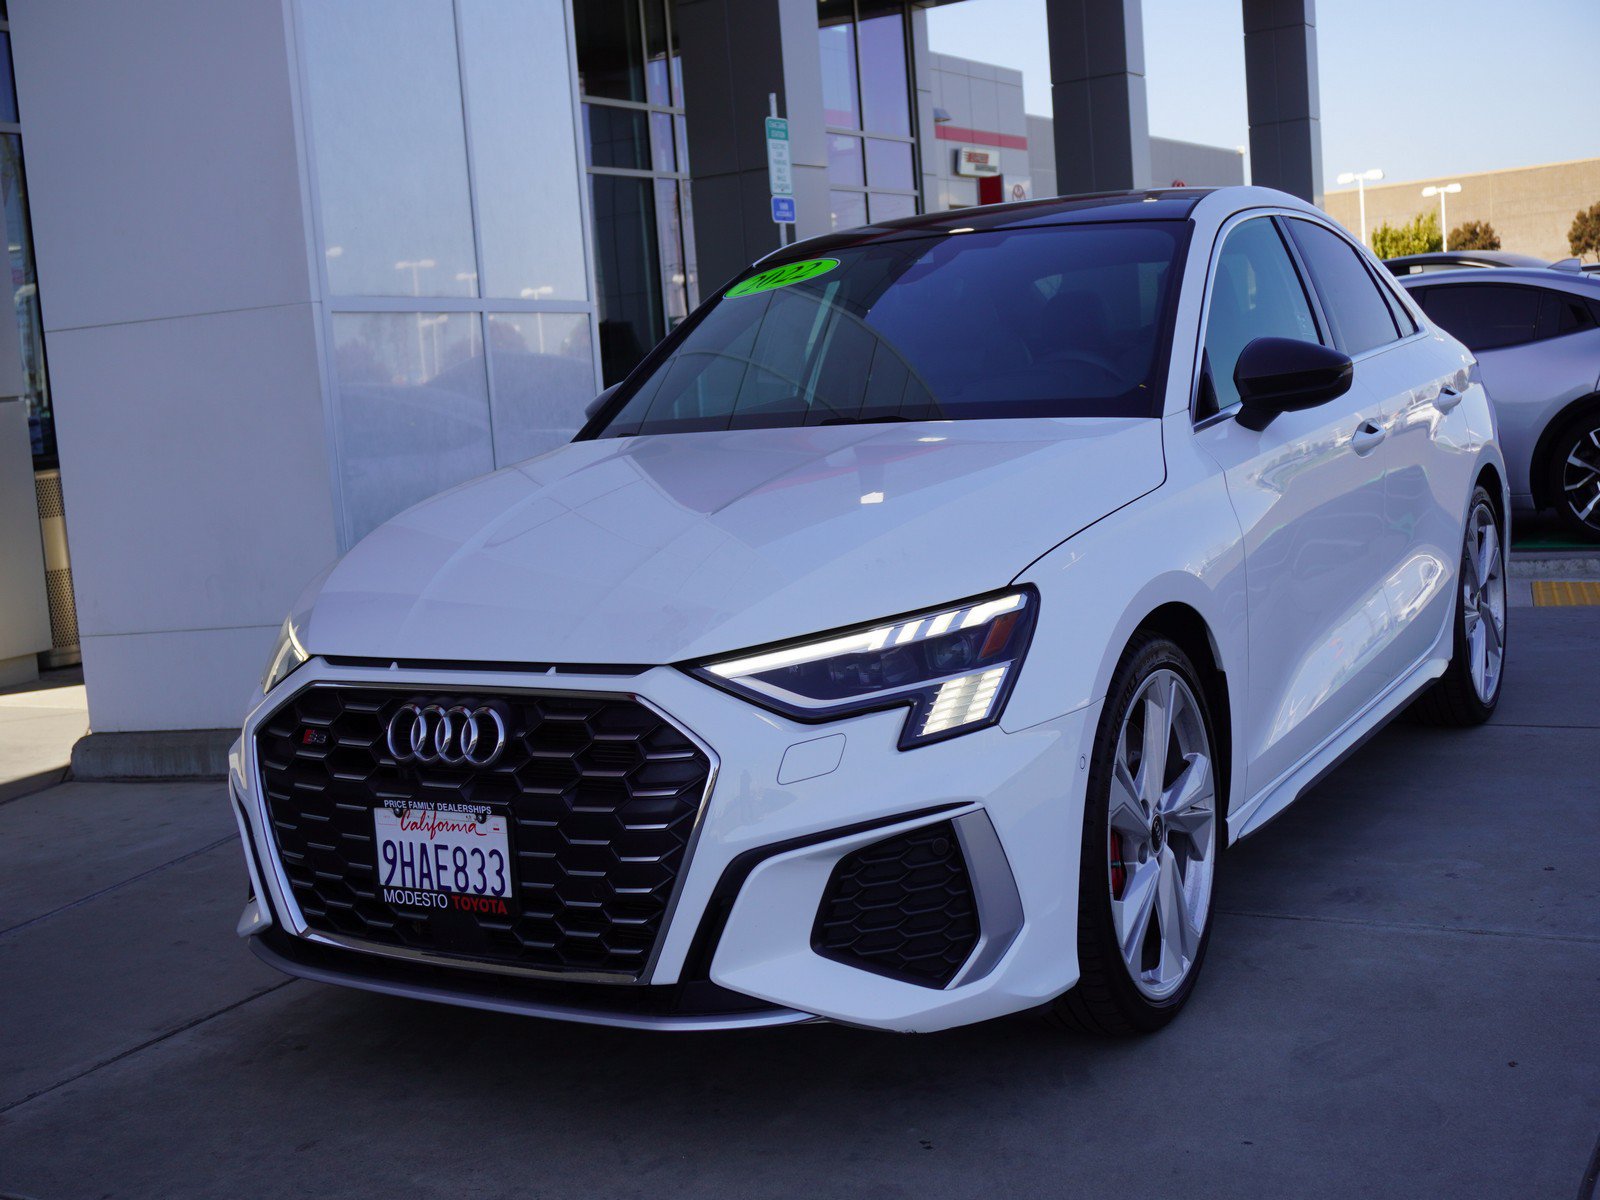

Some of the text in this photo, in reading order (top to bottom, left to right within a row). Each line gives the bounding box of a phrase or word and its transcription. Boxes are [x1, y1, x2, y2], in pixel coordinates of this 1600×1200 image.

[736, 261, 822, 294] 2022
[384, 800, 492, 815] PRICE FAMILY DEALERSHIPS
[400, 809, 487, 840] California
[382, 840, 506, 897] 9HAE833
[384, 889, 508, 914] MODESTO TOYOTA
